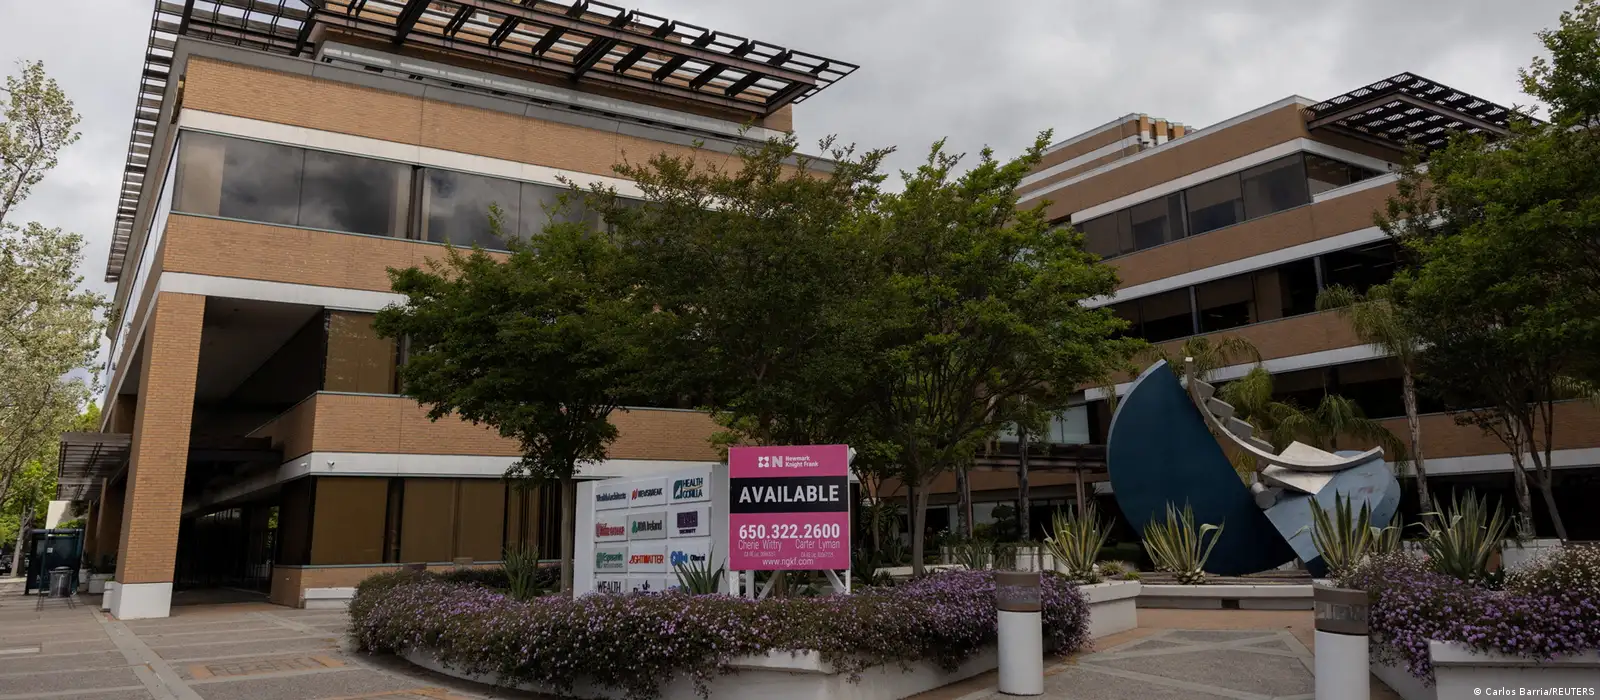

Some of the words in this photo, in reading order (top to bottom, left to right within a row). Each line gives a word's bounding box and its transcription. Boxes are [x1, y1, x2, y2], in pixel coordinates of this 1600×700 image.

[683, 477, 703, 487] HEALTH
[683, 489, 703, 499] GORILLA
[739, 484, 839, 504] AVAILABLE
[647, 520, 662, 531] Ireland
[739, 523, 840, 539] 650.322.2600
[738, 540, 759, 550] Cherie
[762, 539, 782, 552] Wittry
[795, 539, 815, 550] Carter
[818, 539, 840, 551] Lyman
[762, 556, 814, 567] www.ngkf.com
[597, 581, 621, 594] WEALTH
